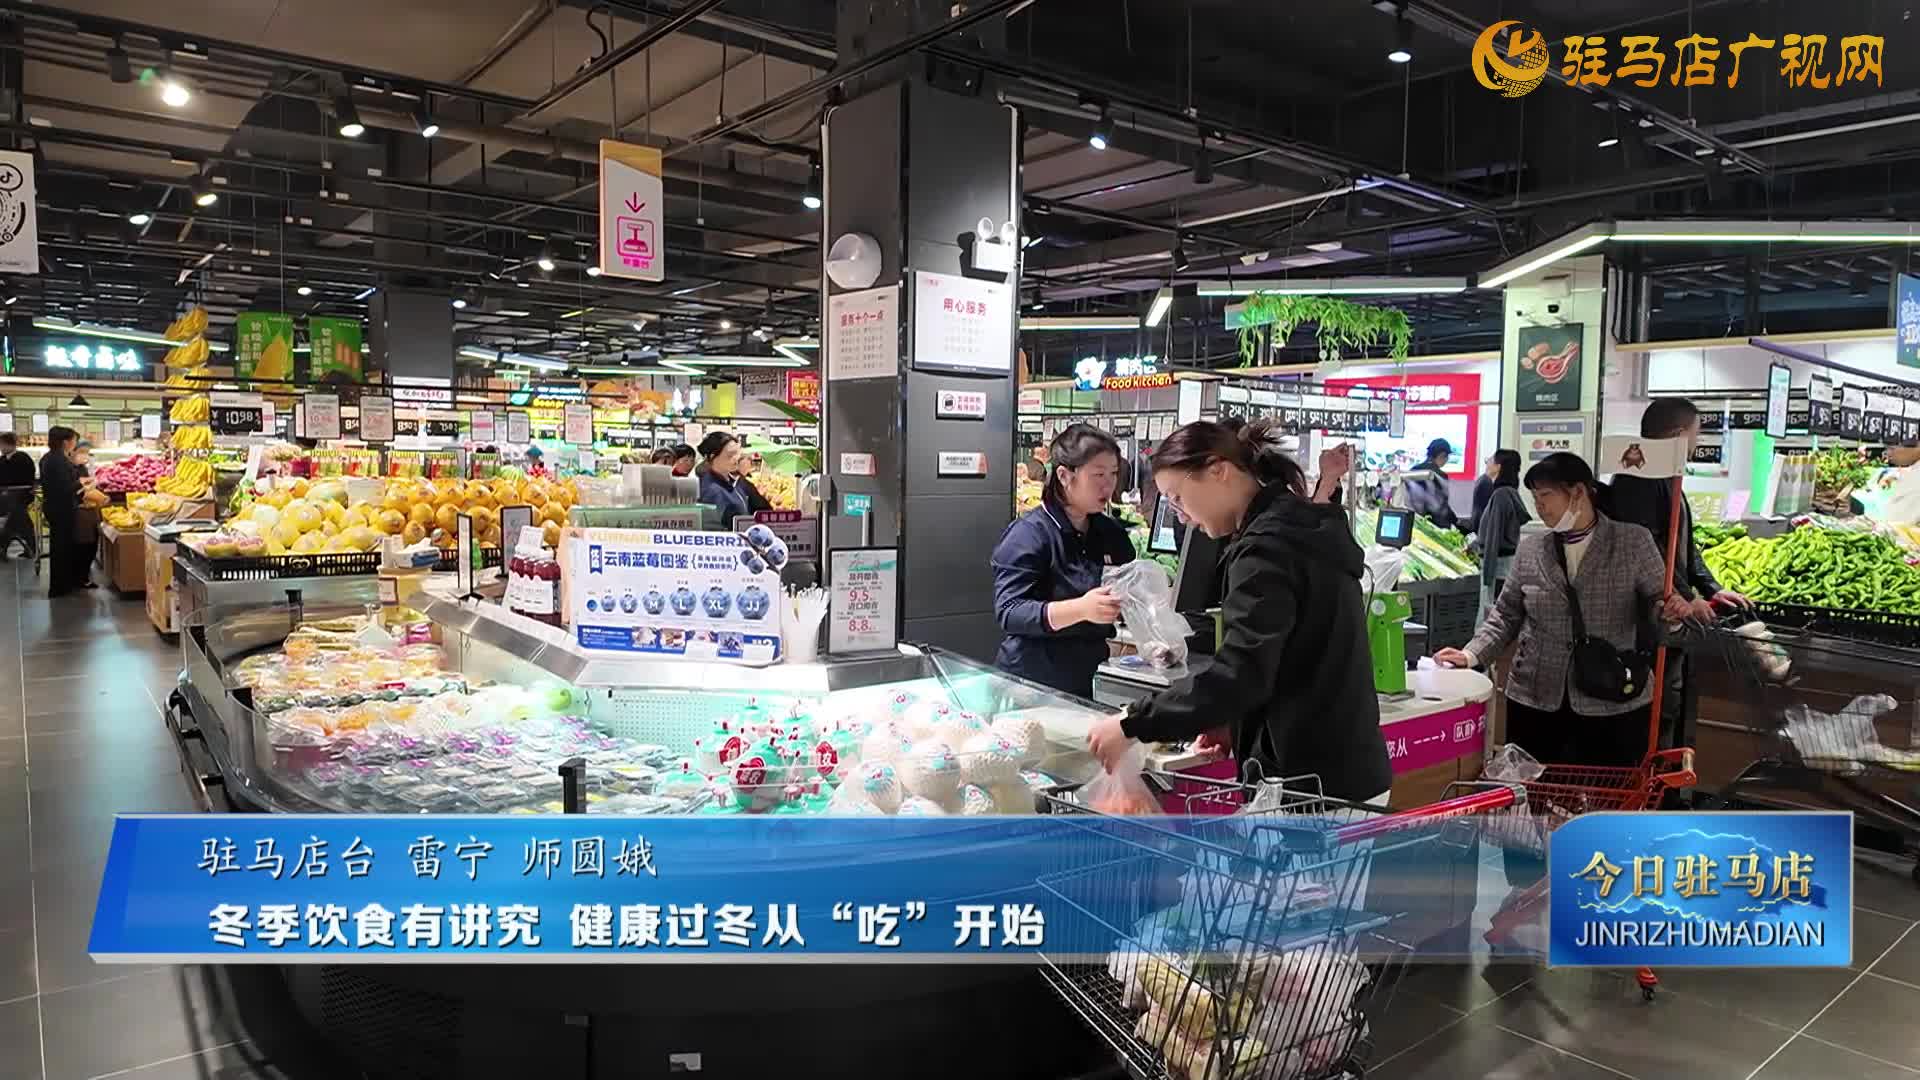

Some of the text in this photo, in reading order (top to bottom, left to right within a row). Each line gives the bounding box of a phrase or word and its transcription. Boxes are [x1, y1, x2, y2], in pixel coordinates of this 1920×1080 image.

[943, 297, 988, 316] 用心服务
[1105, 374, 1172, 390] Food kitchen
[604, 551, 689, 570] 云南蓝莓图鉴
[650, 601, 658, 609] M
[679, 600, 686, 609] L
[709, 600, 724, 610] XL
[747, 600, 760, 611] JJ
